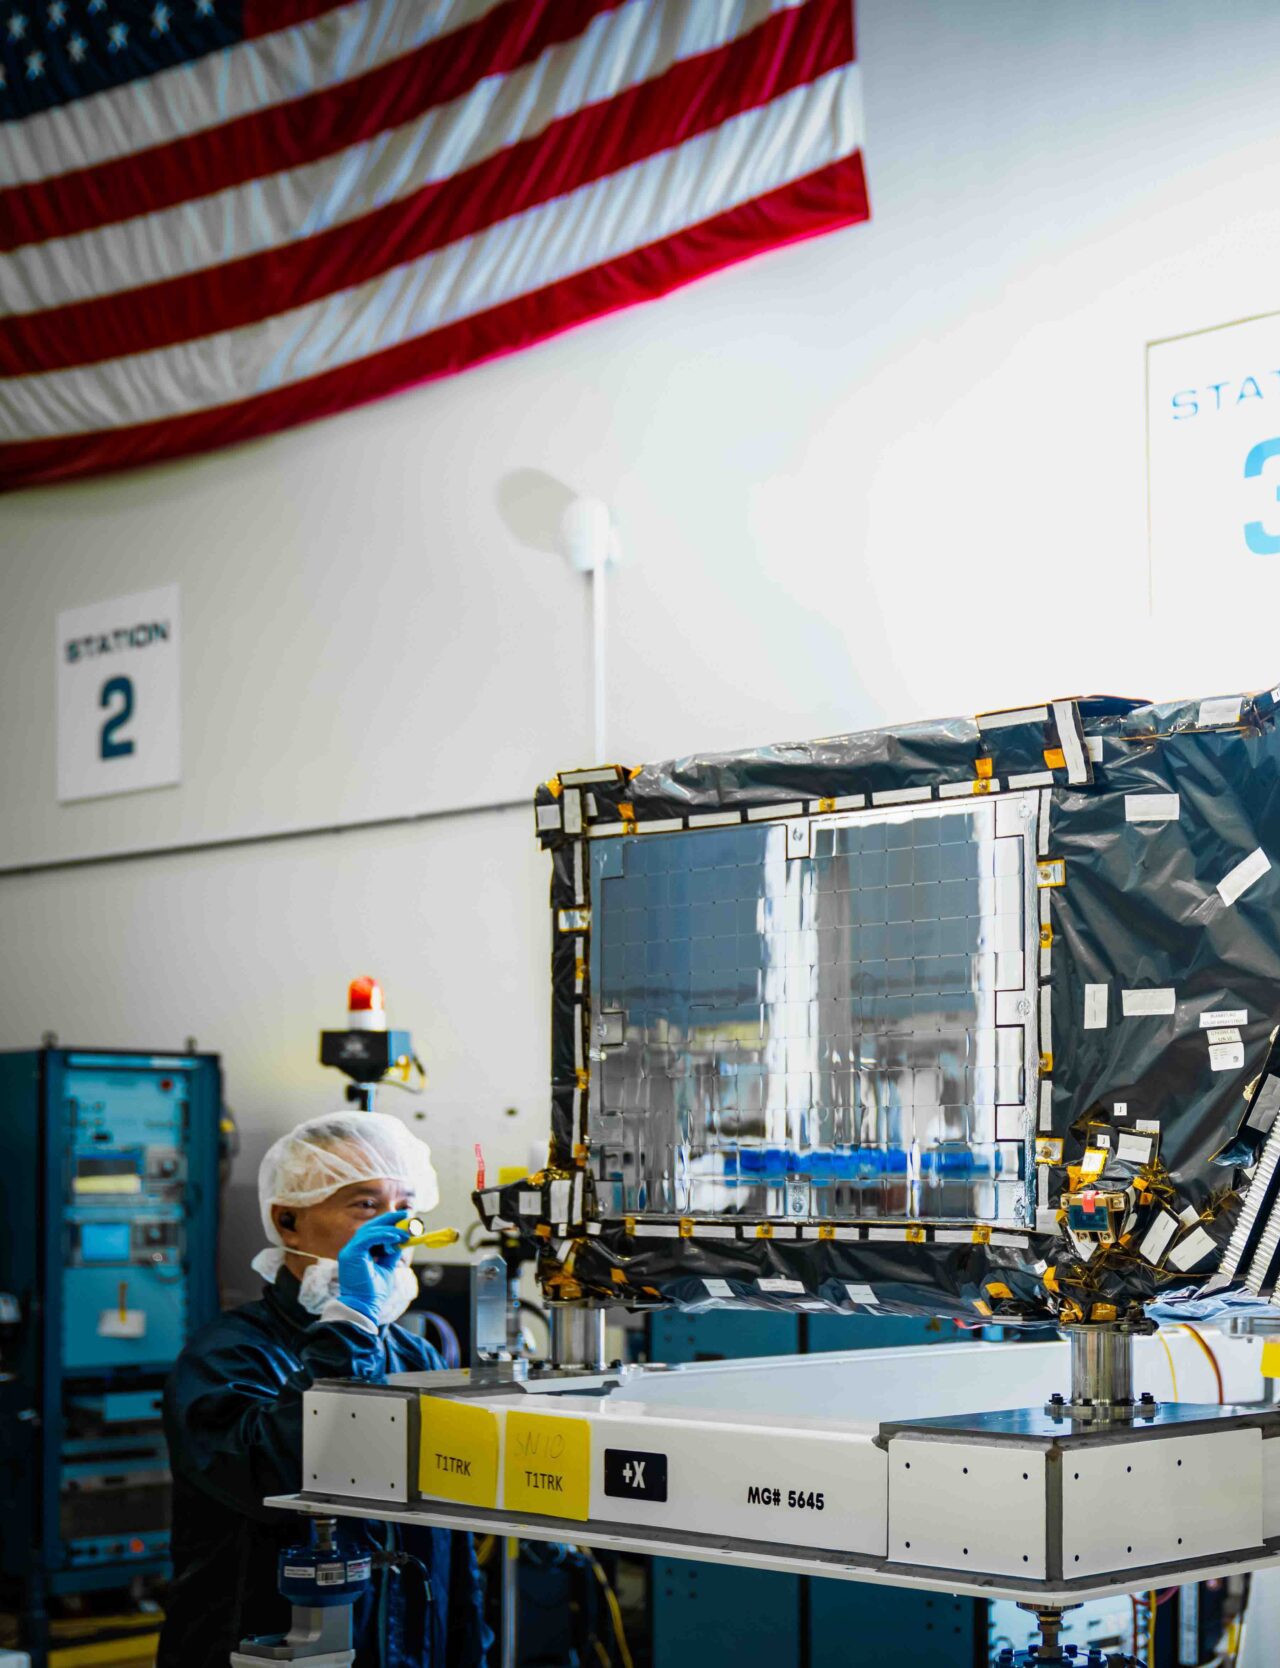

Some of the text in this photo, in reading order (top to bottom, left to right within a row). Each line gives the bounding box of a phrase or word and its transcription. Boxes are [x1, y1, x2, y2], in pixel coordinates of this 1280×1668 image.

[65, 620, 170, 664] STATION
[98, 674, 135, 762] 2
[435, 1453, 472, 1477] T1TRK
[623, 1460, 646, 1489] +X
[525, 1471, 563, 1492] T1TRK
[747, 1486, 825, 1511] MG# 5645
